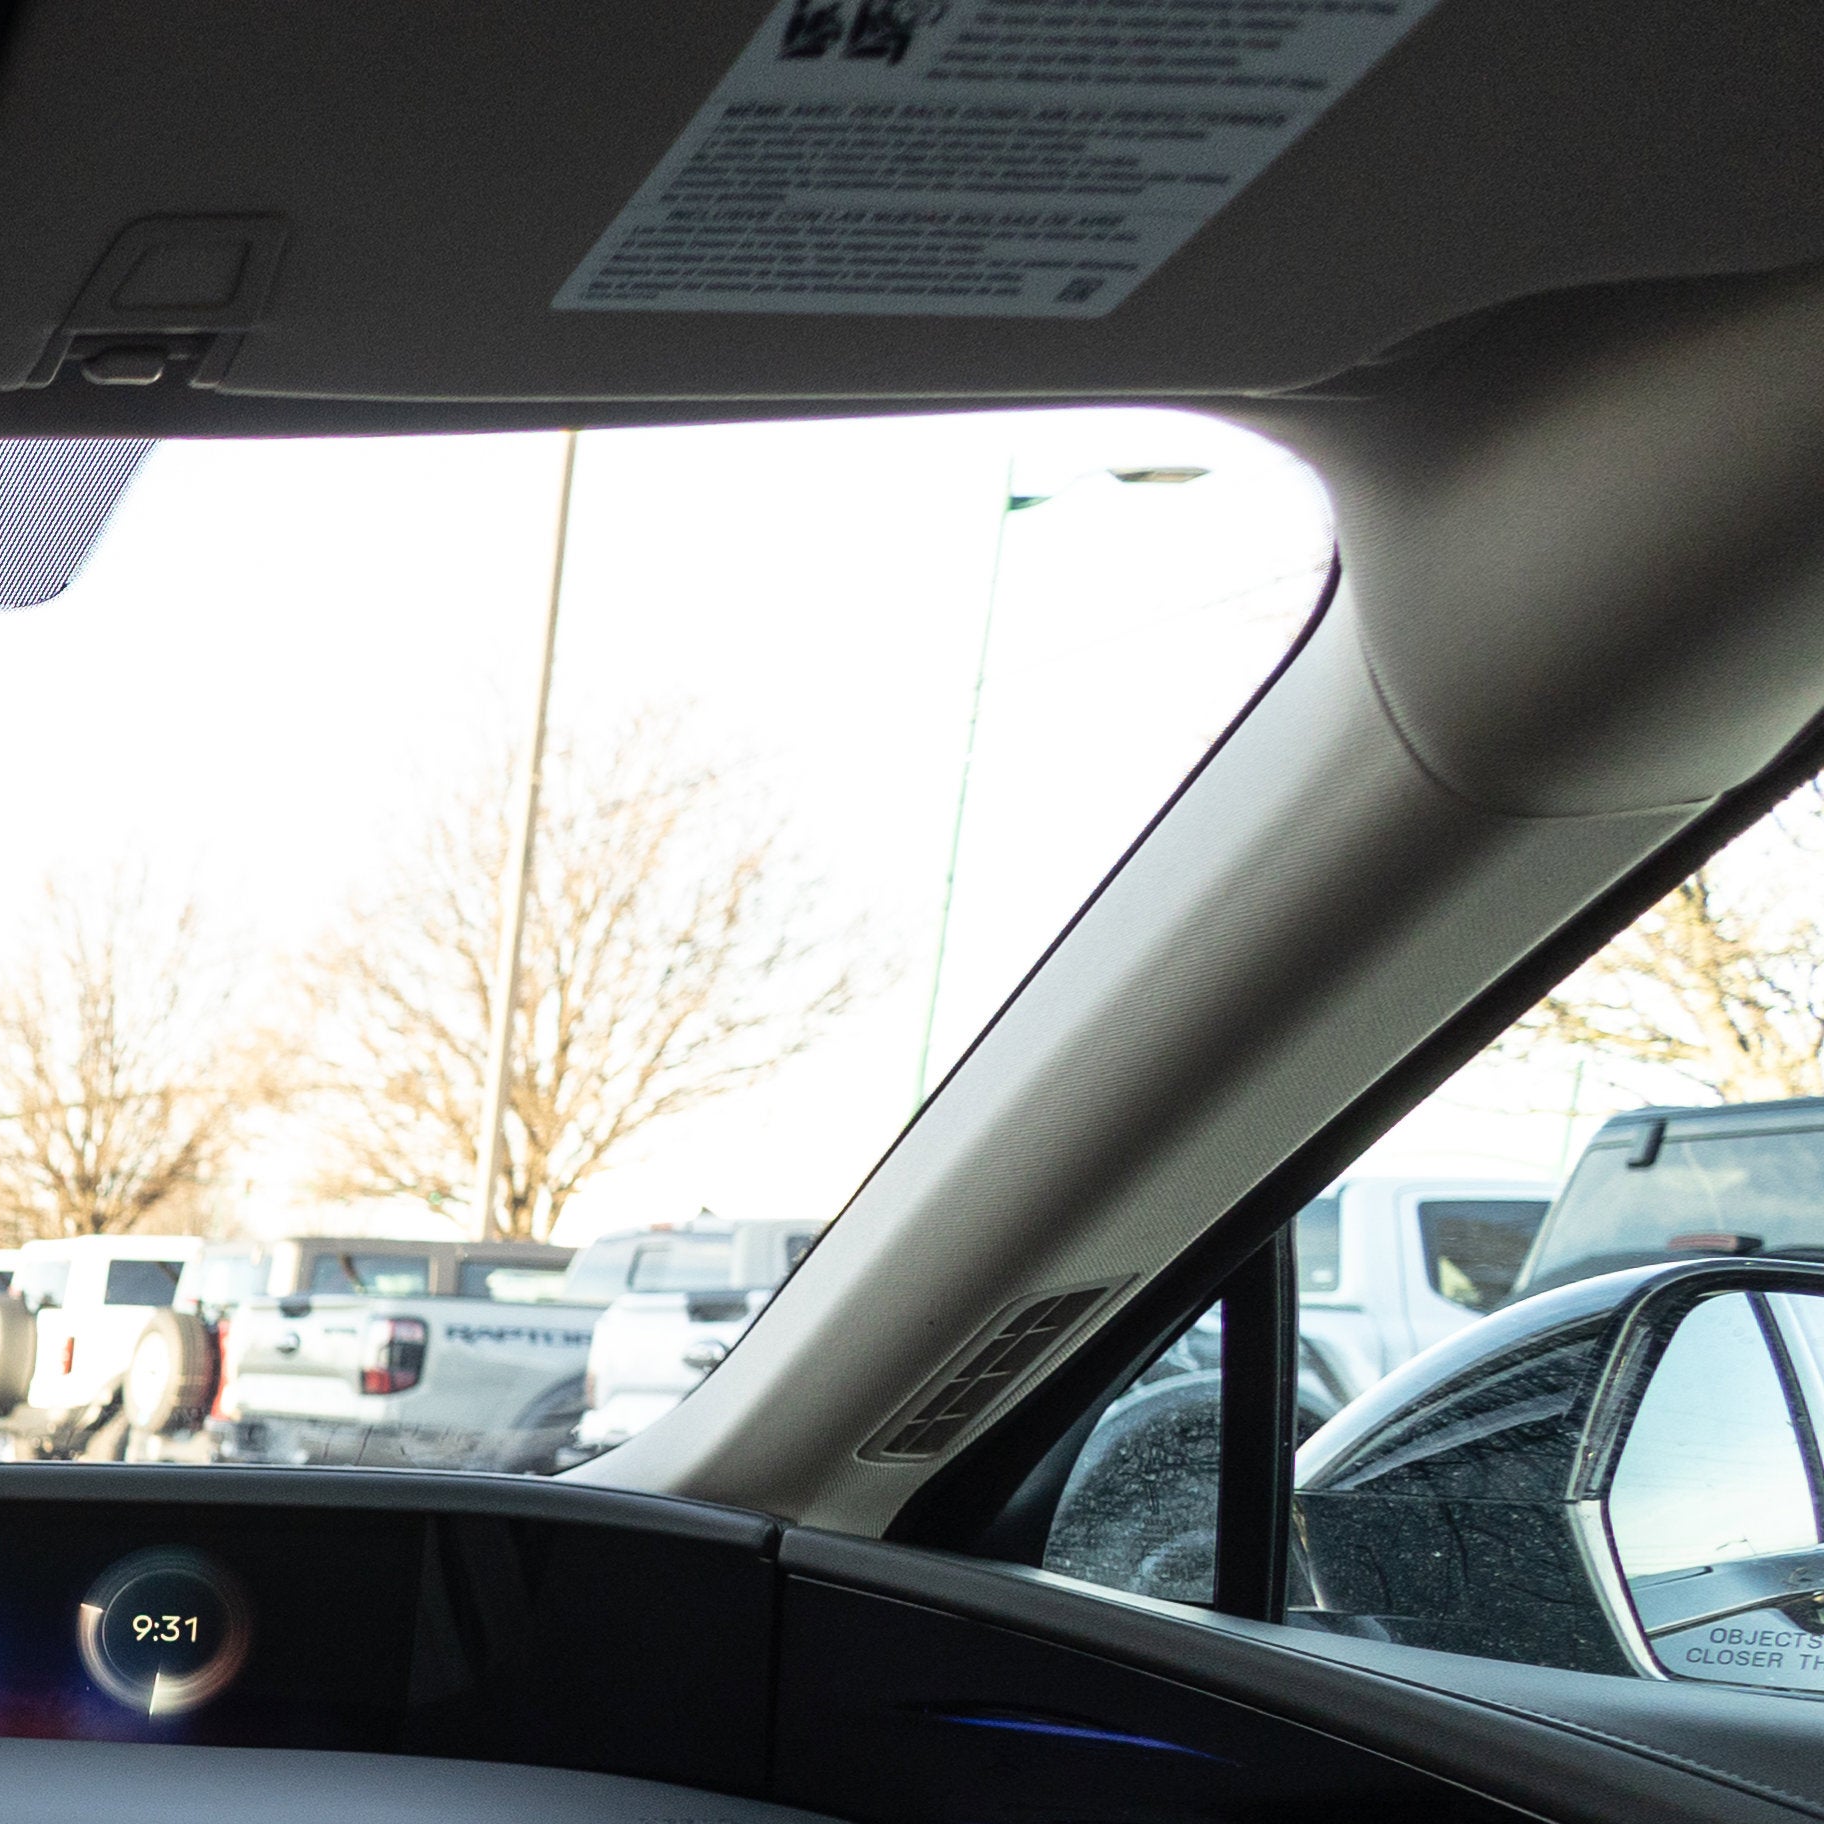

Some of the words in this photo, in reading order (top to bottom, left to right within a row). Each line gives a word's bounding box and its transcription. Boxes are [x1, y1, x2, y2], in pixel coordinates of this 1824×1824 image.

[132, 1614, 199, 1643] 9:31
[1709, 1627, 1824, 1650] OBJECTS
[1685, 1647, 1784, 1669] CLOSER
